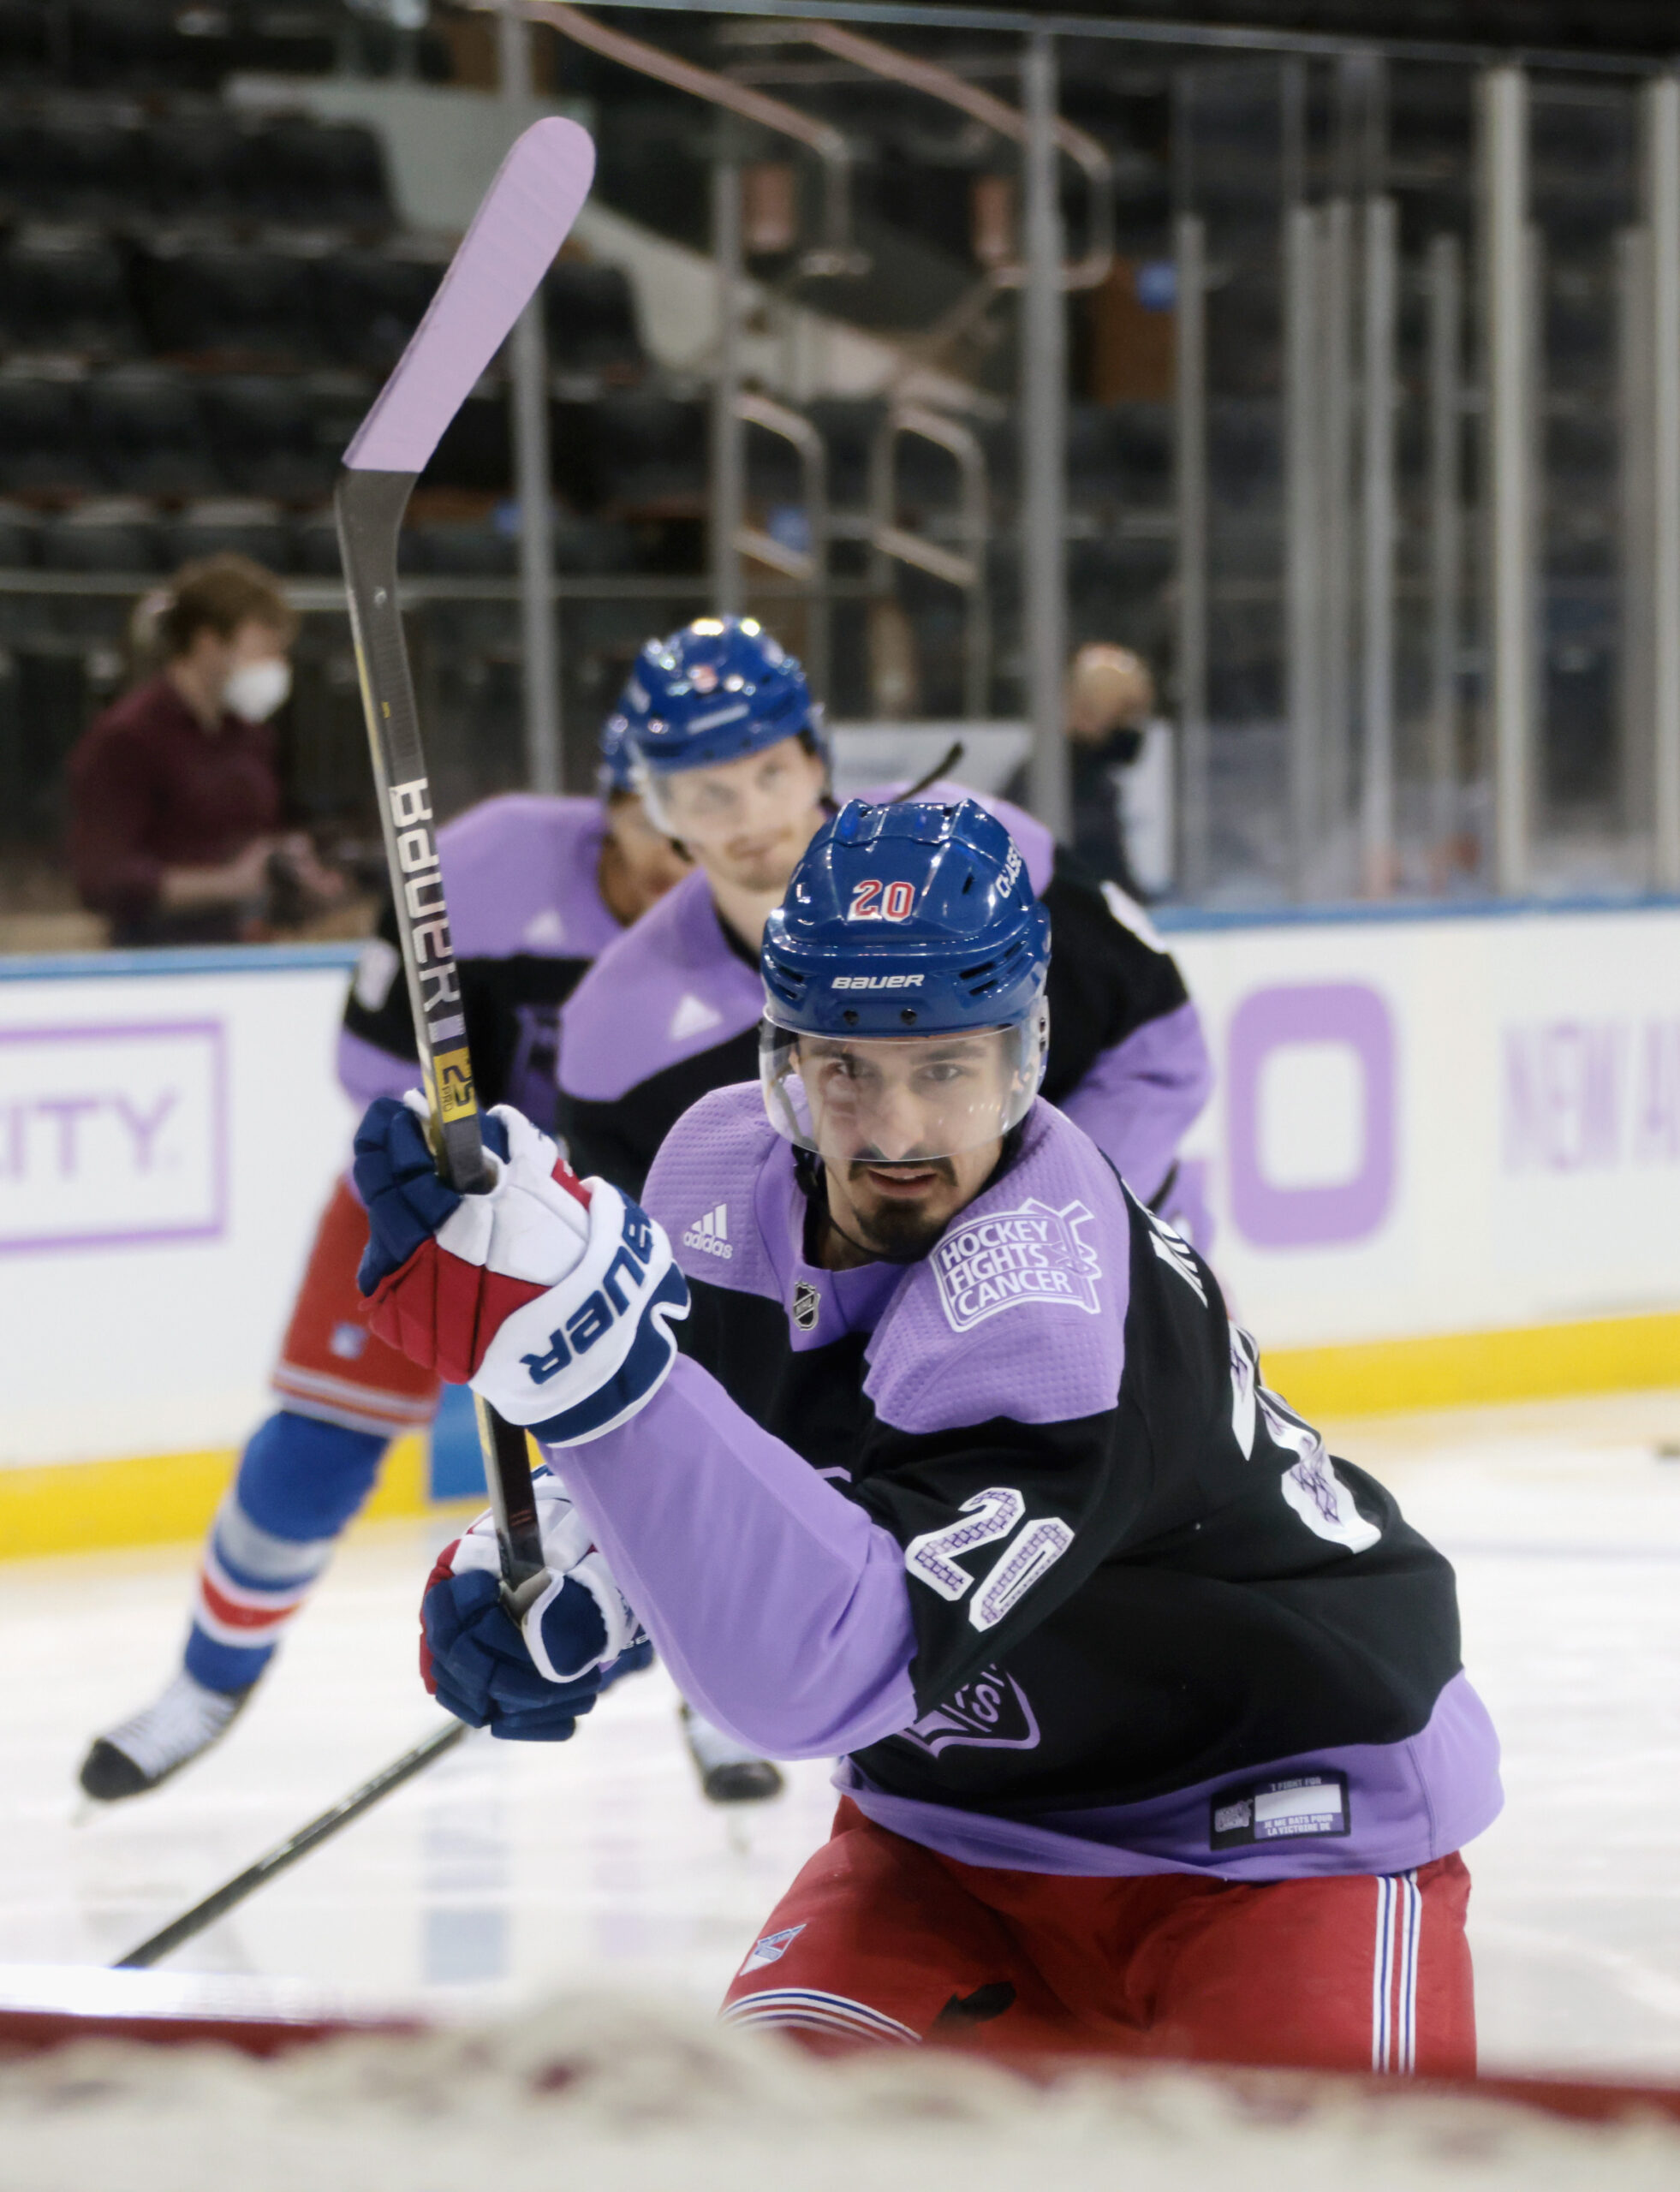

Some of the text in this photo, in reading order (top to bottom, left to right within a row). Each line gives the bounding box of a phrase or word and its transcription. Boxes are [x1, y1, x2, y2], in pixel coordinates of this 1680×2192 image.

[389, 777, 461, 1013] BAUER
[847, 879, 915, 922] 20
[831, 974, 925, 990] BAUER
[0, 1087, 177, 1182] ITY
[683, 1230, 733, 1259] adidas
[940, 1219, 1049, 1271] HOCKEY
[947, 1243, 1050, 1295] FIGHTS
[519, 1199, 658, 1385] AUER
[957, 1269, 1073, 1316] CANCER
[904, 1486, 1075, 1633] 20
[1267, 1827, 1278, 1837] LA
[1274, 1818, 1287, 1827] ME
[1311, 1814, 1333, 1823] POUR
